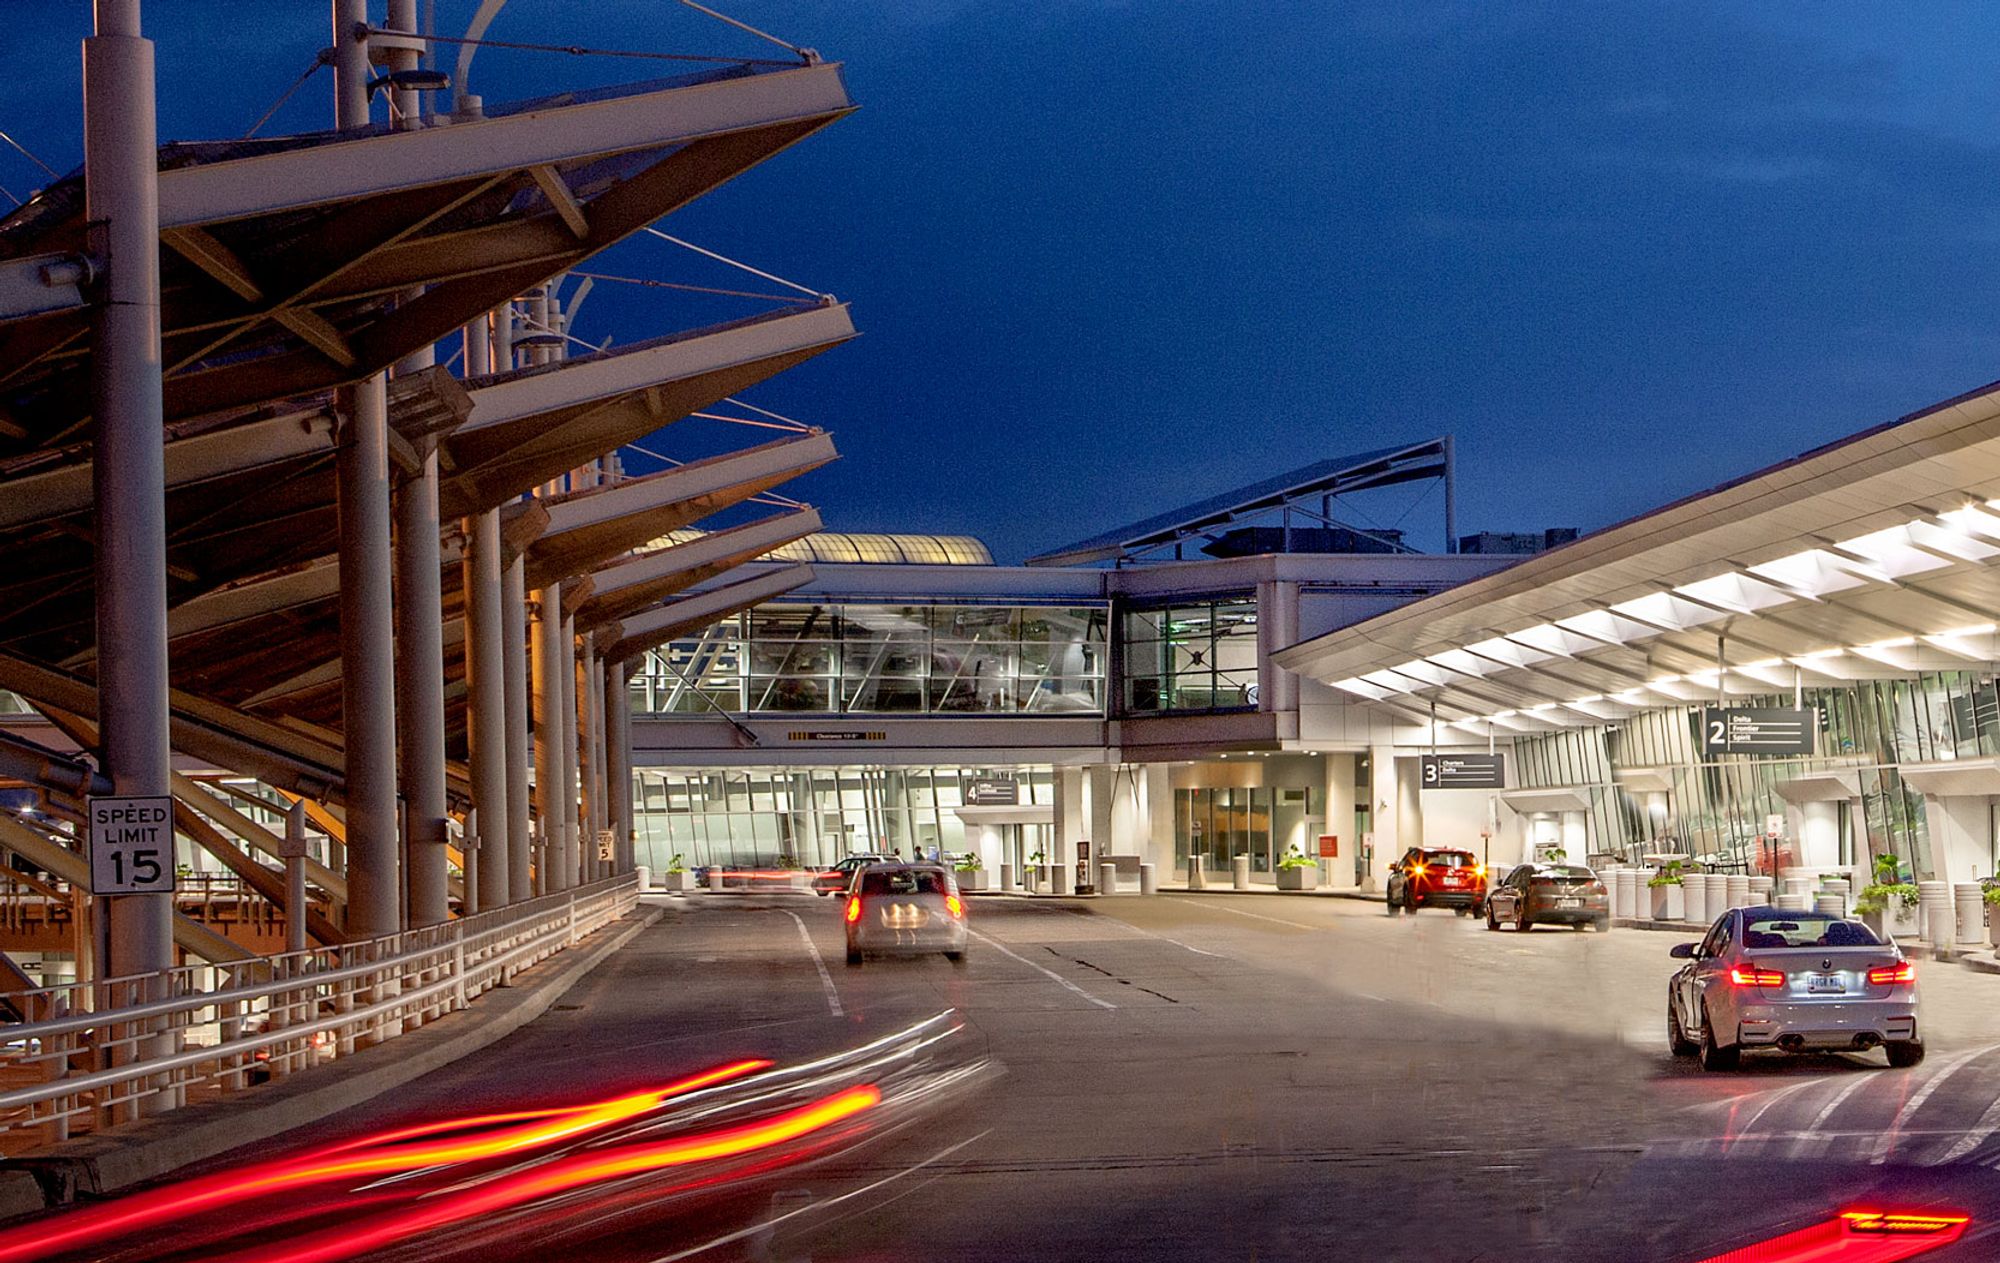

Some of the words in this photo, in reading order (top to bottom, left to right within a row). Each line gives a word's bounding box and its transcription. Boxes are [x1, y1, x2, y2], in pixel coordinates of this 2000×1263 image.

[1709, 721, 1725, 744] 2
[1733, 734, 1751, 742] Spirit
[1425, 764, 1437, 782] 3
[968, 786, 976, 800] 4
[97, 808, 166, 824] SPEED
[105, 828, 158, 844] LIMIT
[111, 850, 161, 885] 15
